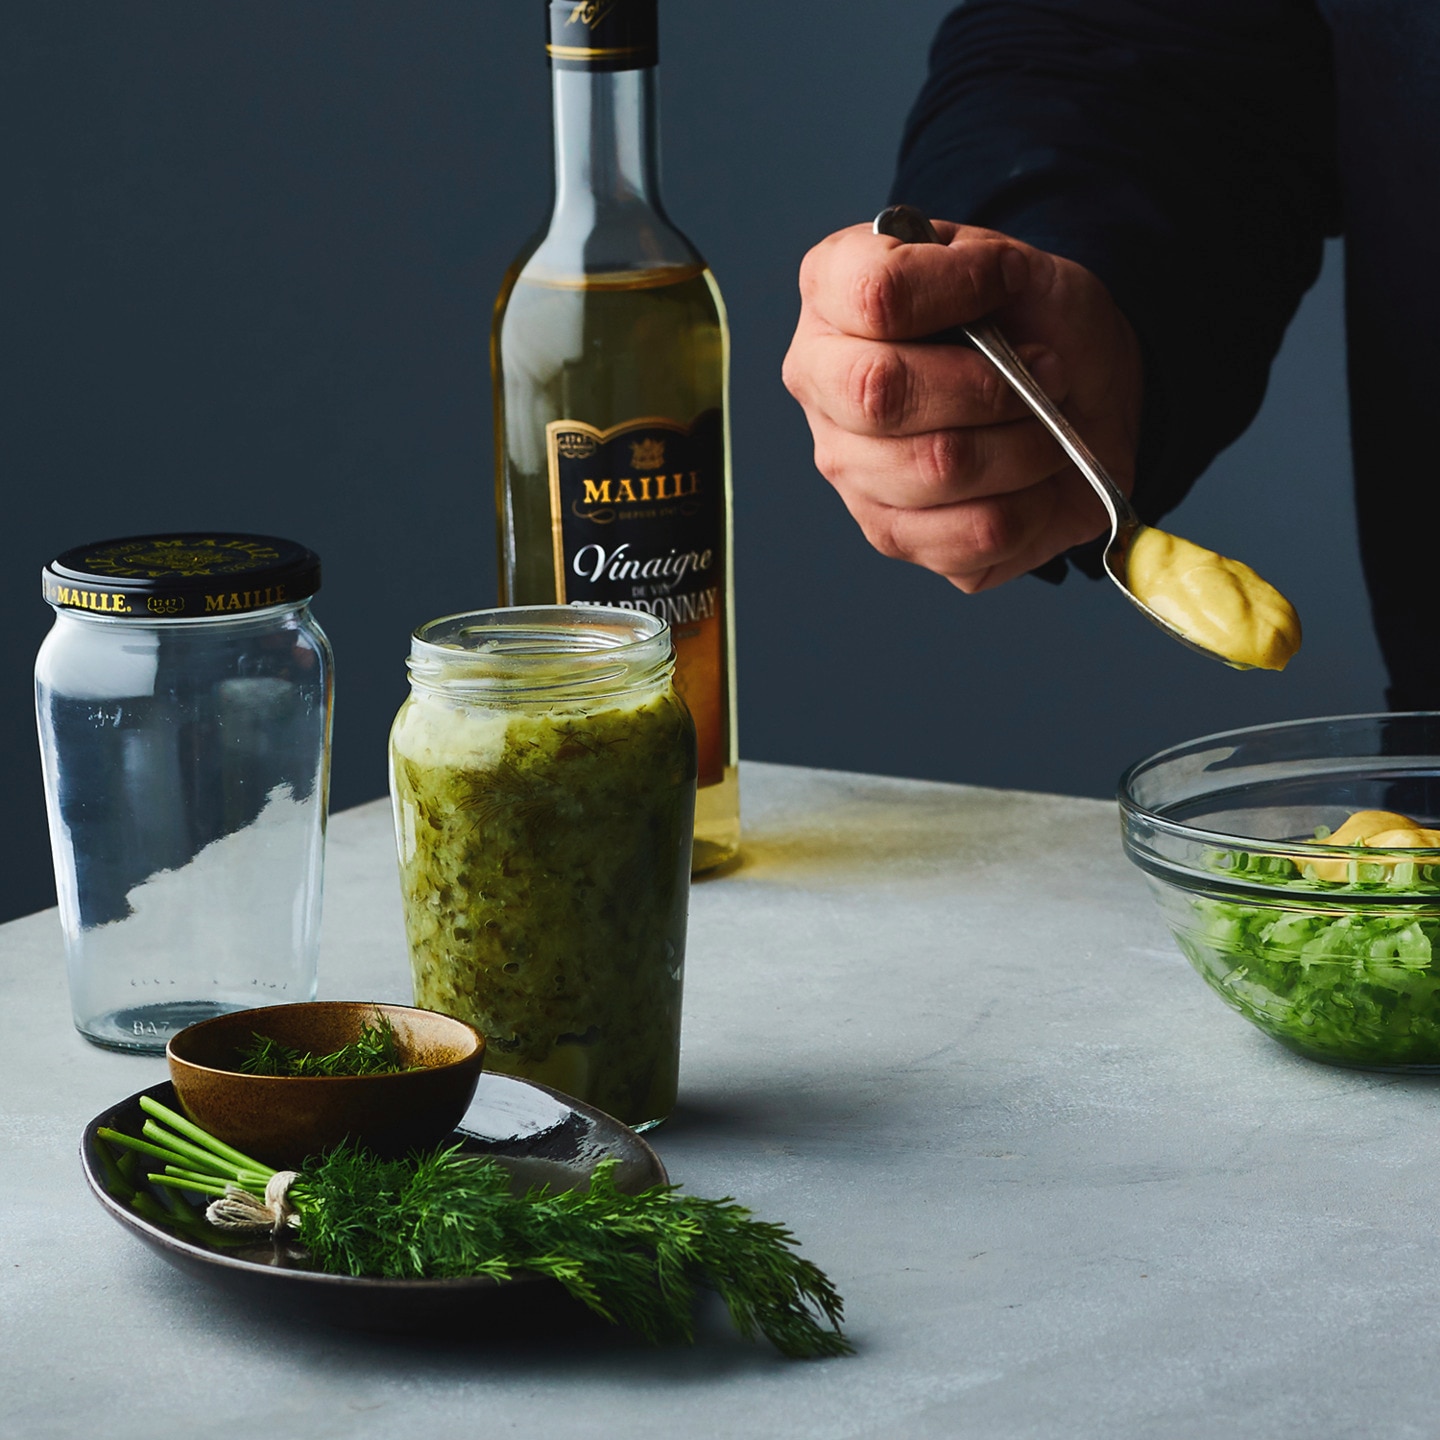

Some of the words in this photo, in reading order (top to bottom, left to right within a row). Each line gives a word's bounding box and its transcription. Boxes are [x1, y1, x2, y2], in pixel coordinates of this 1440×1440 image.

[572, 543, 712, 587] Vinaigre
[153, 598, 177, 607] 1747
[204, 584, 287, 612] MAILLE
[570, 587, 718, 625] DONNAY
[631, 585, 645, 597] DE
[649, 583, 671, 596] VIN
